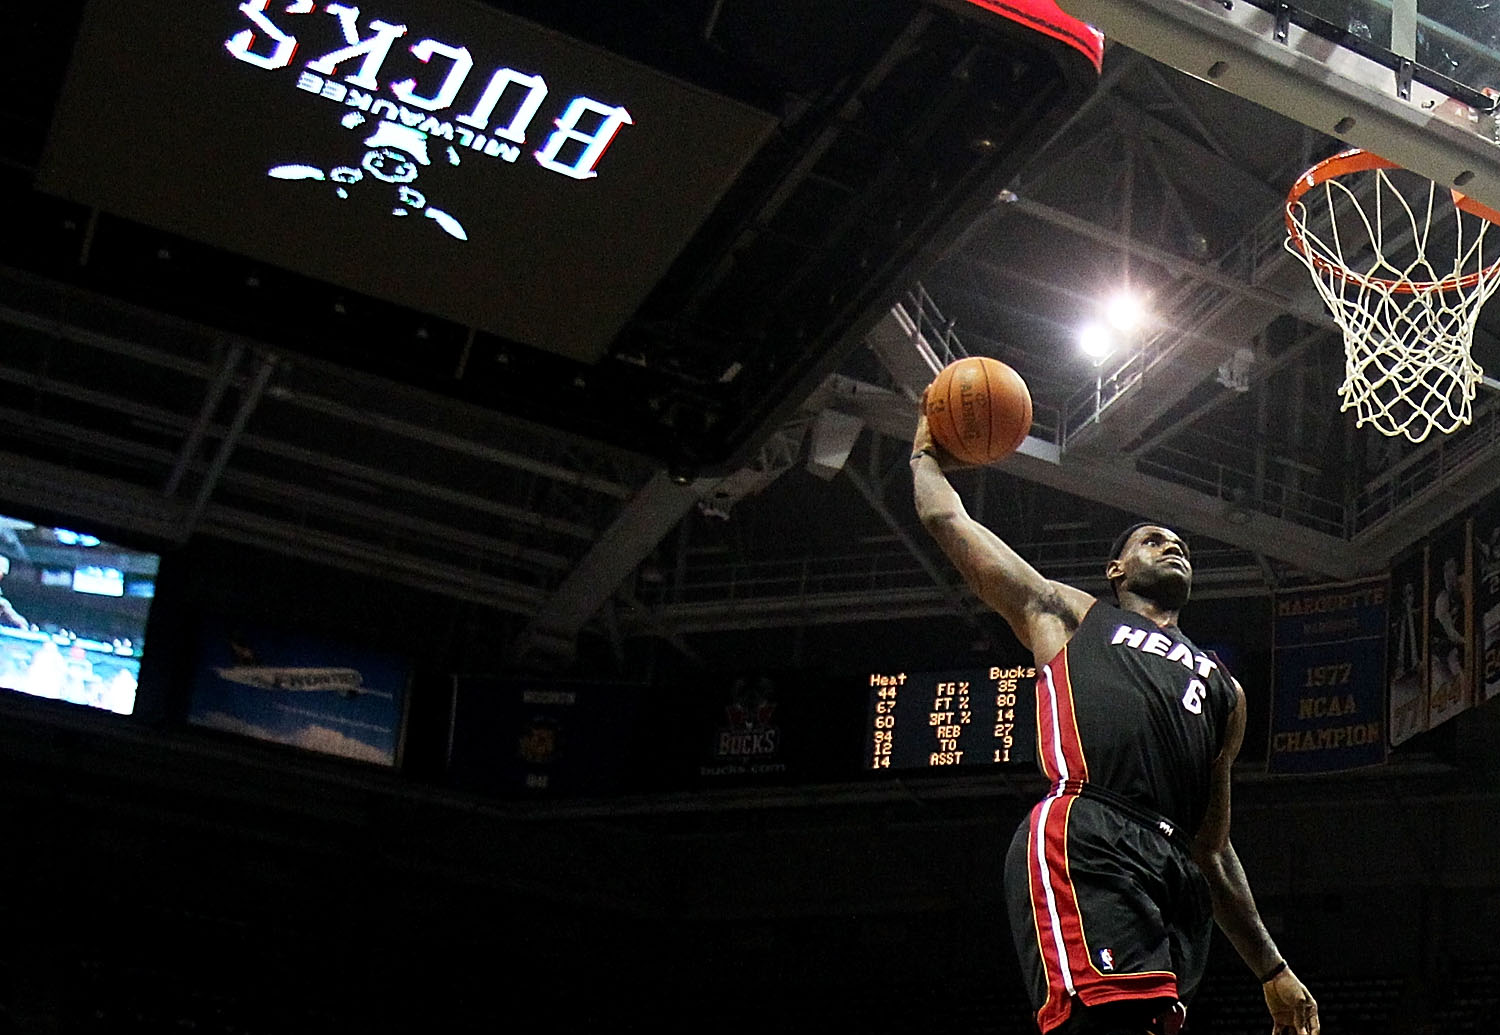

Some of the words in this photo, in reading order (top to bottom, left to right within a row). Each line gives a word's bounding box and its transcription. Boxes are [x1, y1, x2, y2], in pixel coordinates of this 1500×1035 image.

[225, 0, 635, 180] BUCKS
[298, 71, 521, 164] MILWAUKEE
[1111, 624, 1218, 679] HEAT
[870, 673, 907, 686] Heat
[989, 666, 1036, 680] Bucks
[1304, 663, 1352, 689] 1977
[937, 683, 956, 696] FG
[958, 682, 970, 695] %
[998, 680, 1017, 692] 35
[878, 687, 897, 699] 44
[1182, 678, 1206, 715] 6
[934, 698, 953, 711] FT
[959, 697, 970, 709] %
[997, 694, 1016, 707] 80
[1298, 694, 1357, 720] NCAA
[876, 701, 896, 714] 67
[929, 712, 955, 726] 3PT
[960, 712, 971, 724] %
[997, 710, 1015, 721] 14
[875, 716, 895, 729] 60
[937, 726, 961, 738] REB
[994, 724, 1014, 737] 27
[718, 727, 777, 757] BUCKS
[874, 731, 893, 744] 34
[1003, 736, 1013, 748] 9
[1273, 723, 1384, 752] CHAMPION
[874, 744, 892, 755] 12
[940, 739, 957, 752] TO
[929, 752, 963, 766] ASST
[994, 750, 1010, 762] 11
[872, 757, 891, 769] 14
